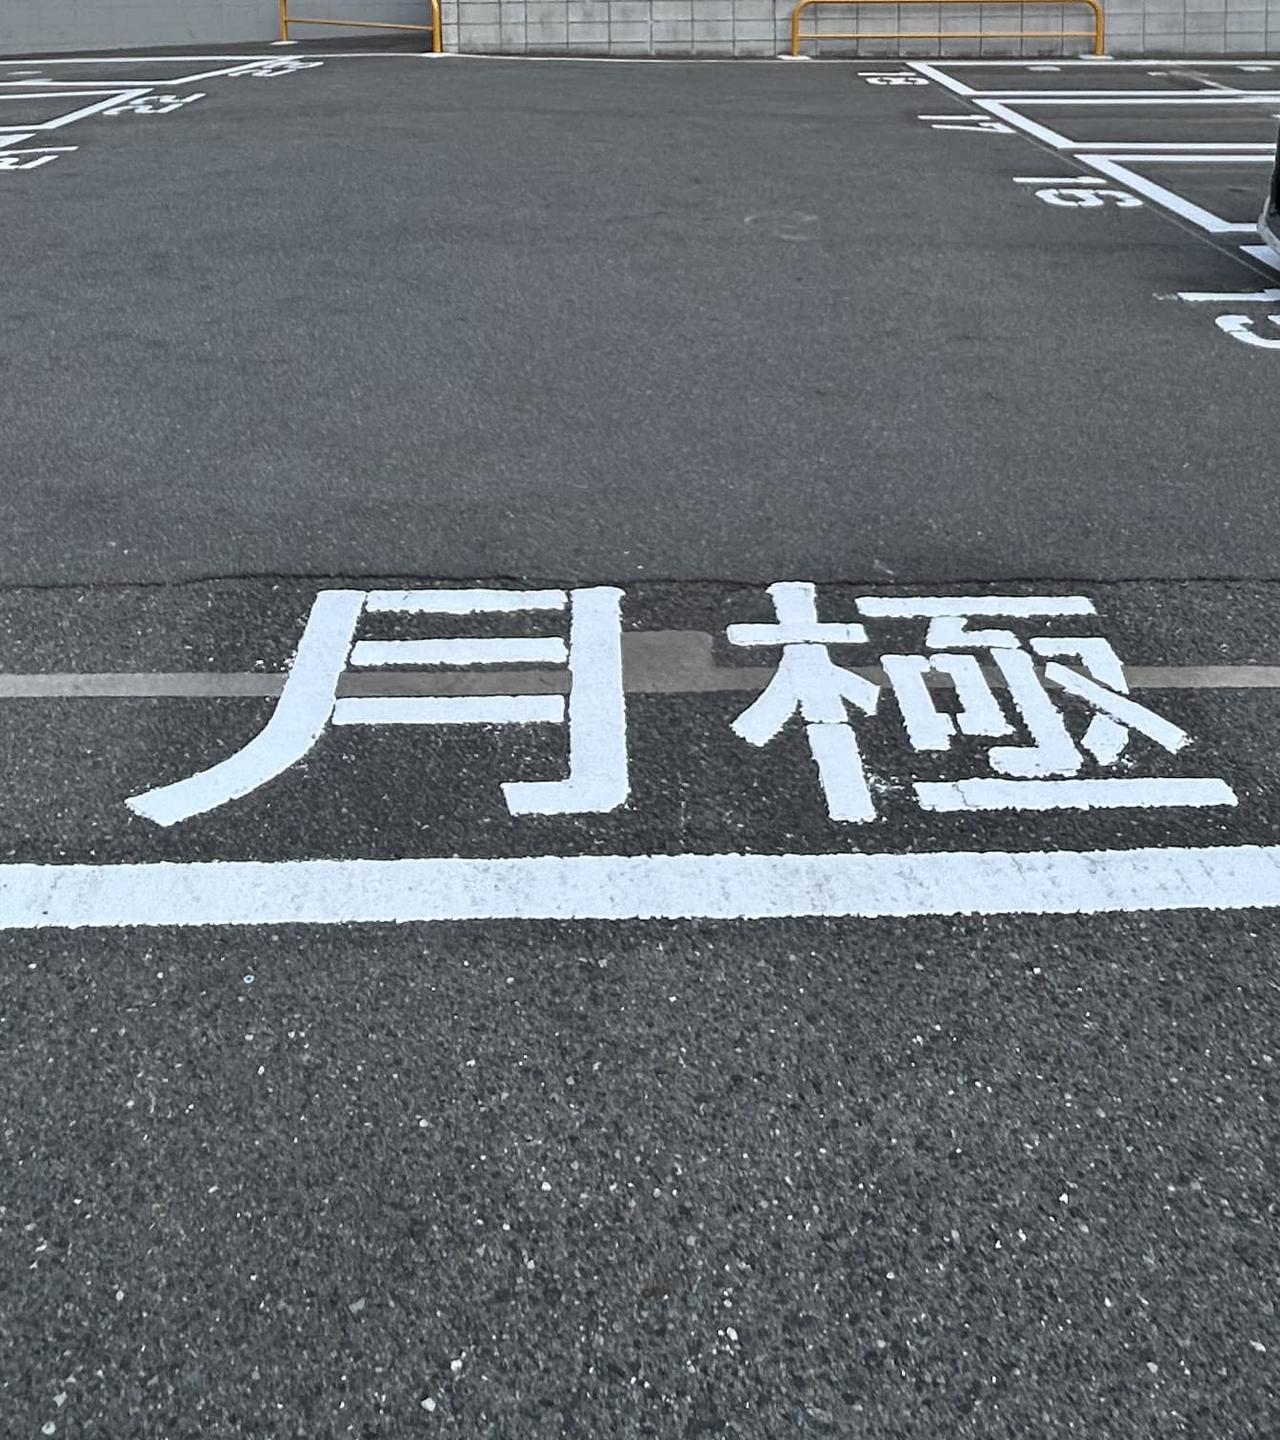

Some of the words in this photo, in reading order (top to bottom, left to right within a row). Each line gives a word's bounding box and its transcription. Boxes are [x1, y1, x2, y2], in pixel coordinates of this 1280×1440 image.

[857, 71, 930, 86] 18
[917, 114, 1017, 134] 17
[1012, 175, 1144, 208] 16
[123, 580, 1241, 827] 月極
